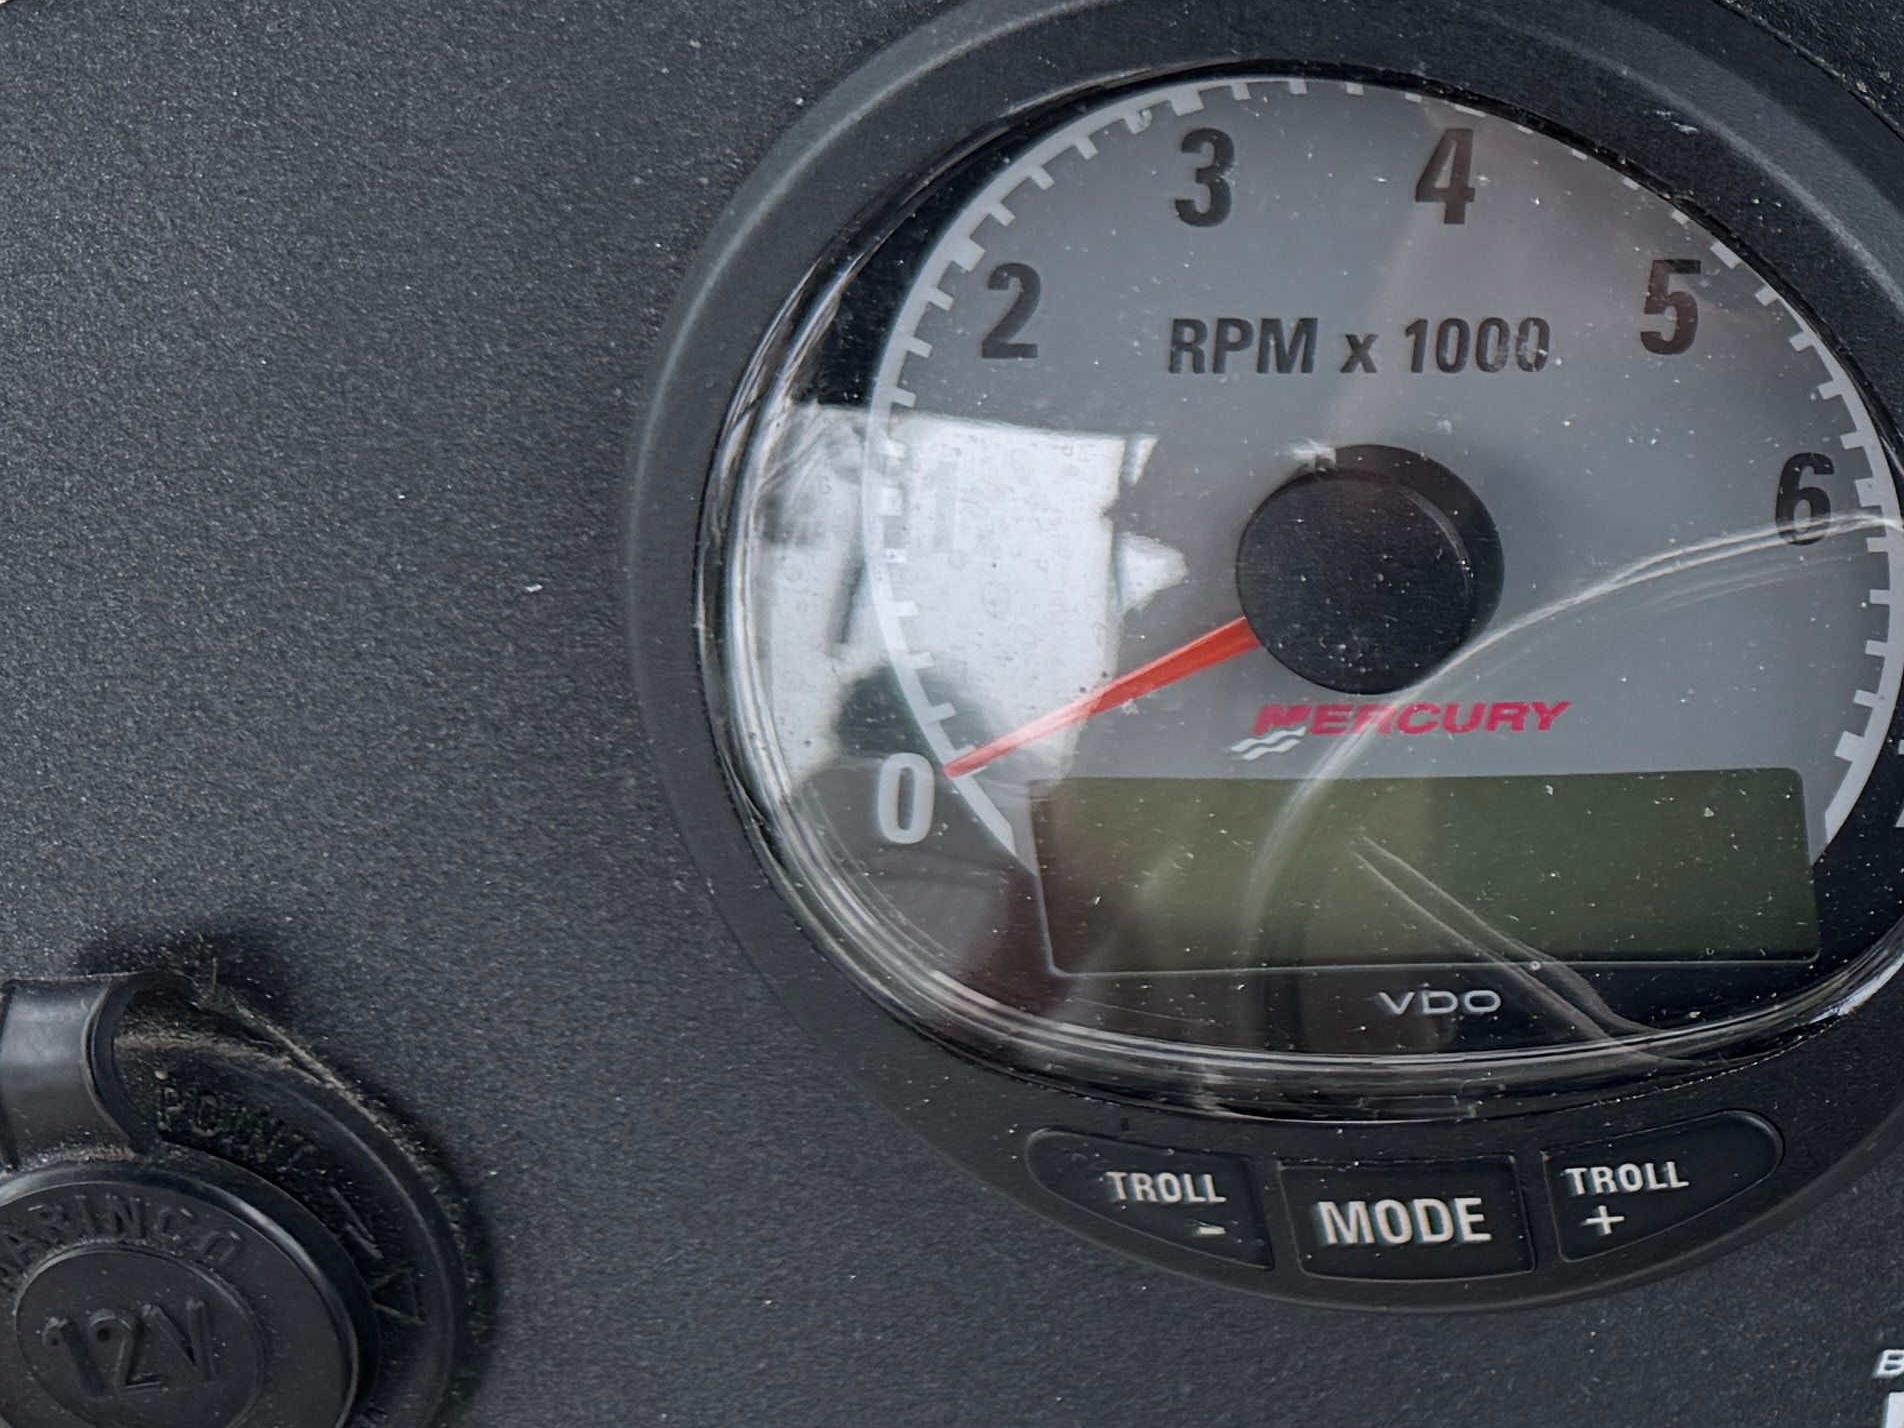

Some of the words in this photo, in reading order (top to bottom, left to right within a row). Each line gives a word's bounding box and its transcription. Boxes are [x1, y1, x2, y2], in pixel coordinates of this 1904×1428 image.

[1174, 127, 1234, 226] 3
[1414, 127, 1475, 224] 4
[981, 262, 1040, 358] 2
[1641, 256, 1704, 355] 5
[1168, 317, 1317, 373] RPM
[1340, 333, 1375, 373] x
[1405, 317, 1549, 373] 1000
[1775, 452, 1835, 547] 6
[1253, 700, 1574, 736] MERCURY
[878, 755, 936, 843] 0
[1378, 990, 1500, 1015] VDO
[1106, 1171, 1225, 1203] TROLL
[1565, 1162, 1688, 1195] TROLL
[1317, 1198, 1490, 1244] MODE
